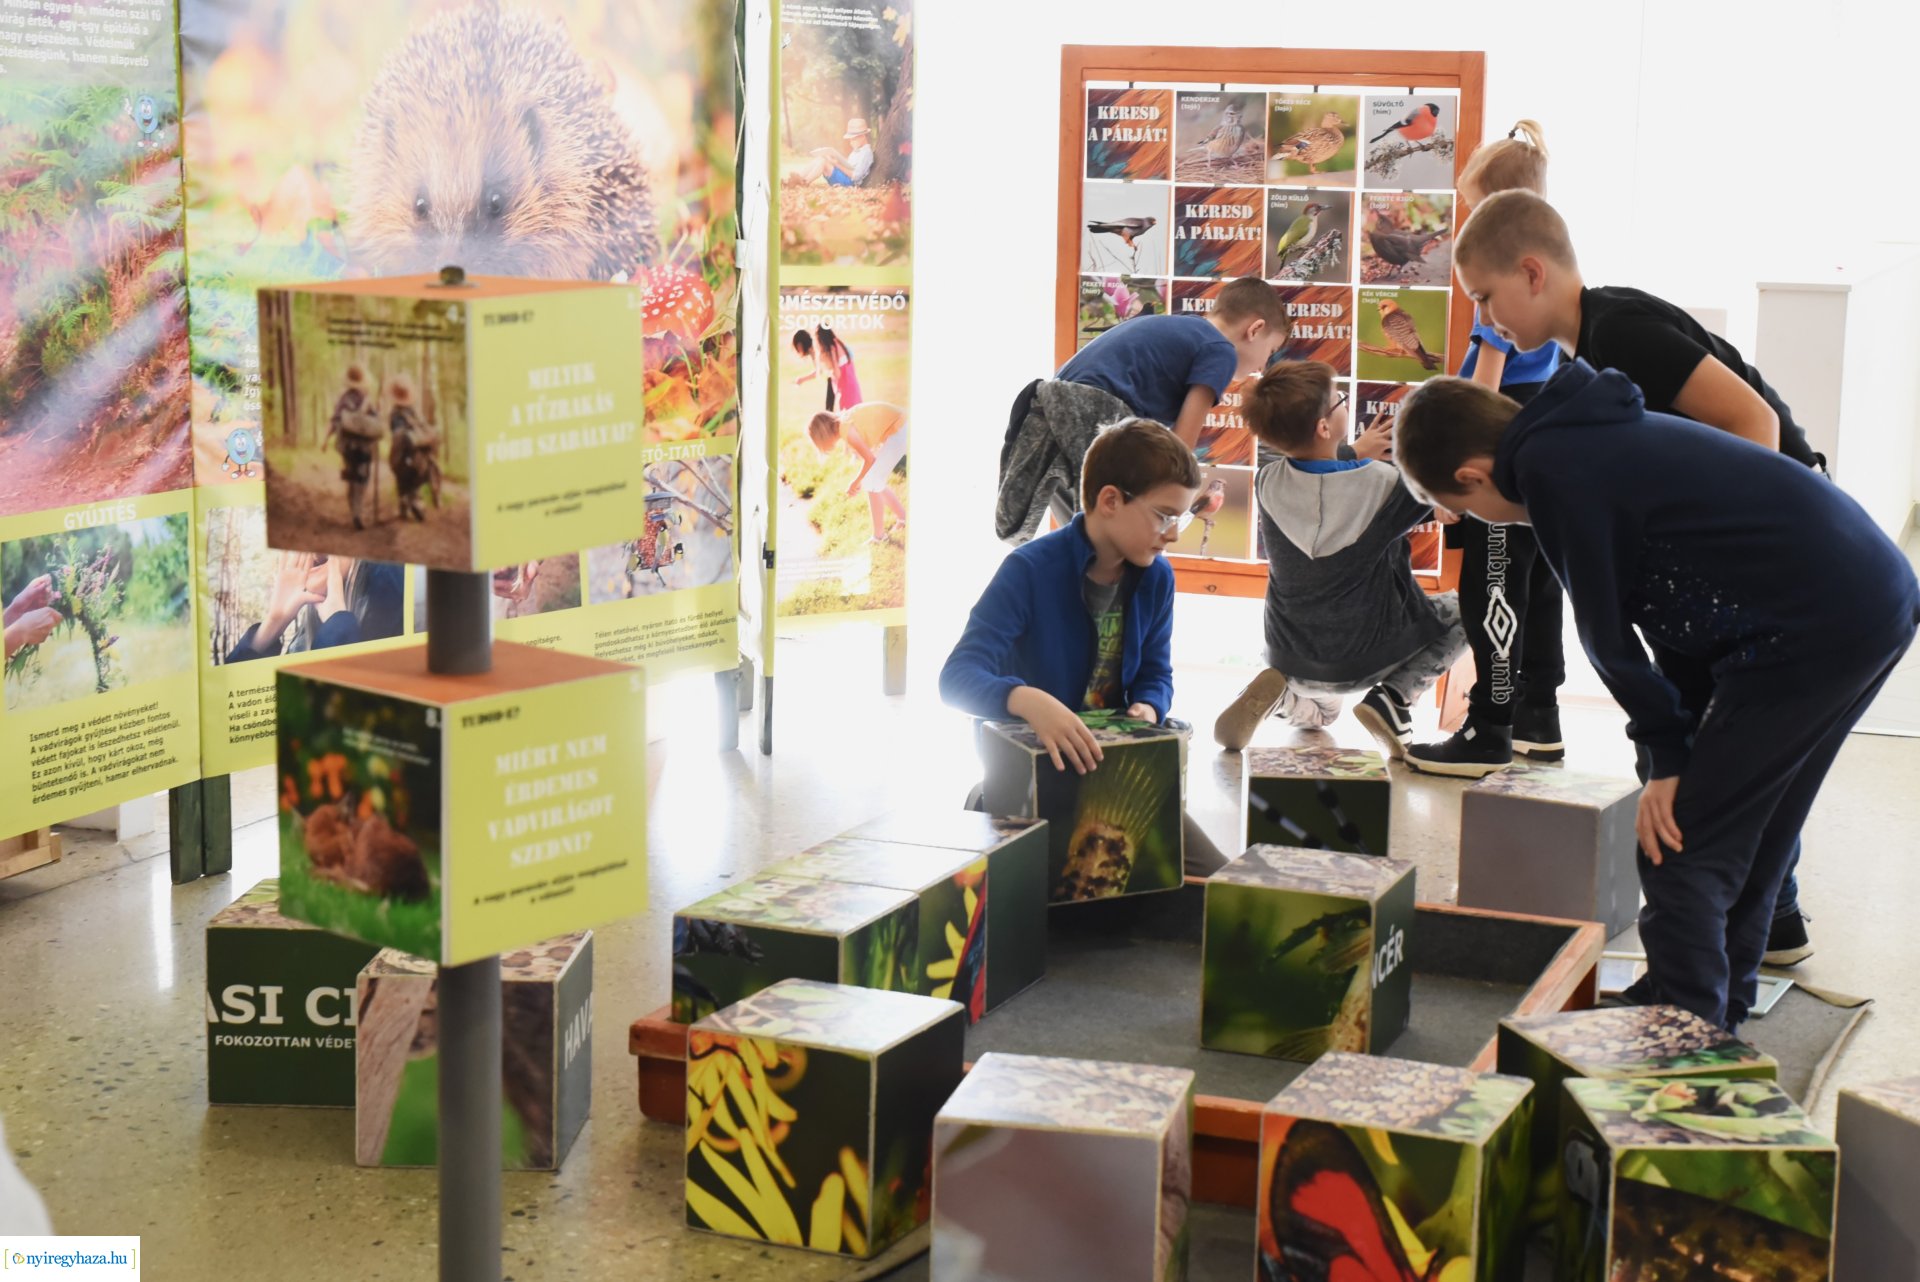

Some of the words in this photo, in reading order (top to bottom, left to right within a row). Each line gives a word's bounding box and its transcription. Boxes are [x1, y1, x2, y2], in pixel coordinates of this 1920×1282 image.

[43, 2, 72, 14] egyes
[73, 3, 87, 16] fa,
[89, 5, 127, 18] minden
[129, 9, 149, 20] szál
[27, 15, 56, 30] érték,
[58, 20, 101, 34] egy-egy
[142, 26, 149, 36] a
[72, 50, 108, 64] hanem
[1098, 106, 1160, 120] KERESD
[1088, 128, 1098, 141] A
[1102, 125, 1167, 142] PÁRJÁT!
[1185, 204, 1254, 219] KERESD
[1176, 227, 1187, 239] A
[1191, 223, 1262, 241] PÁRJÁT!
[779, 290, 906, 311] RMÉSZETVÉDŐ
[1182, 298, 1216, 311] KER
[1283, 303, 1343, 318] ERESD
[1290, 322, 1351, 339] ÁRJÁT!
[528, 362, 595, 390] MELYEK
[509, 404, 521, 426] A
[525, 392, 614, 425] TŰZRAKÁS
[1366, 400, 1399, 415] KER
[536, 422, 636, 457] SZABÁLYAI?
[64, 501, 136, 529] GYŰJTÉS
[237, 698, 262, 708] vadon
[30, 728, 59, 742] Ismerd
[62, 723, 78, 734] meg
[88, 714, 112, 727] védett
[113, 702, 159, 720] növényeket!
[229, 710, 251, 721] viseli
[30, 746, 36, 754] A
[39, 733, 82, 752] vadvirágok
[84, 725, 117, 742] gyűjtése
[119, 718, 145, 730] közben
[147, 711, 171, 723] fontos
[31, 754, 57, 767] védett
[59, 746, 87, 760] fajokat
[89, 743, 95, 751] is
[97, 733, 141, 749] leszedhetsz
[143, 720, 181, 736] véletlenül.
[495, 744, 559, 775] MIÉRT
[565, 733, 607, 760] NEM
[31, 770, 41, 780] Ez
[43, 766, 63, 777] azon
[64, 757, 86, 770] kívül,
[87, 754, 107, 765] hogy
[108, 746, 124, 757] kárt
[126, 742, 146, 753] okoz,
[148, 737, 164, 747] még
[31, 770, 78, 792] büntetendő
[80, 770, 89, 779] is.
[90, 767, 97, 775] A
[99, 752, 148, 772] vadvirágokat
[149, 748, 165, 759] nem
[32, 788, 67, 804] érdemes
[105, 771, 129, 783] hamar
[131, 756, 178, 776] elhervadnak.
[504, 768, 598, 805] ÉRDEMES
[488, 794, 615, 841] VADVIRÁGOT
[510, 831, 592, 867] SZEDNI?
[215, 1035, 311, 1048] FOKOZOTTAN
